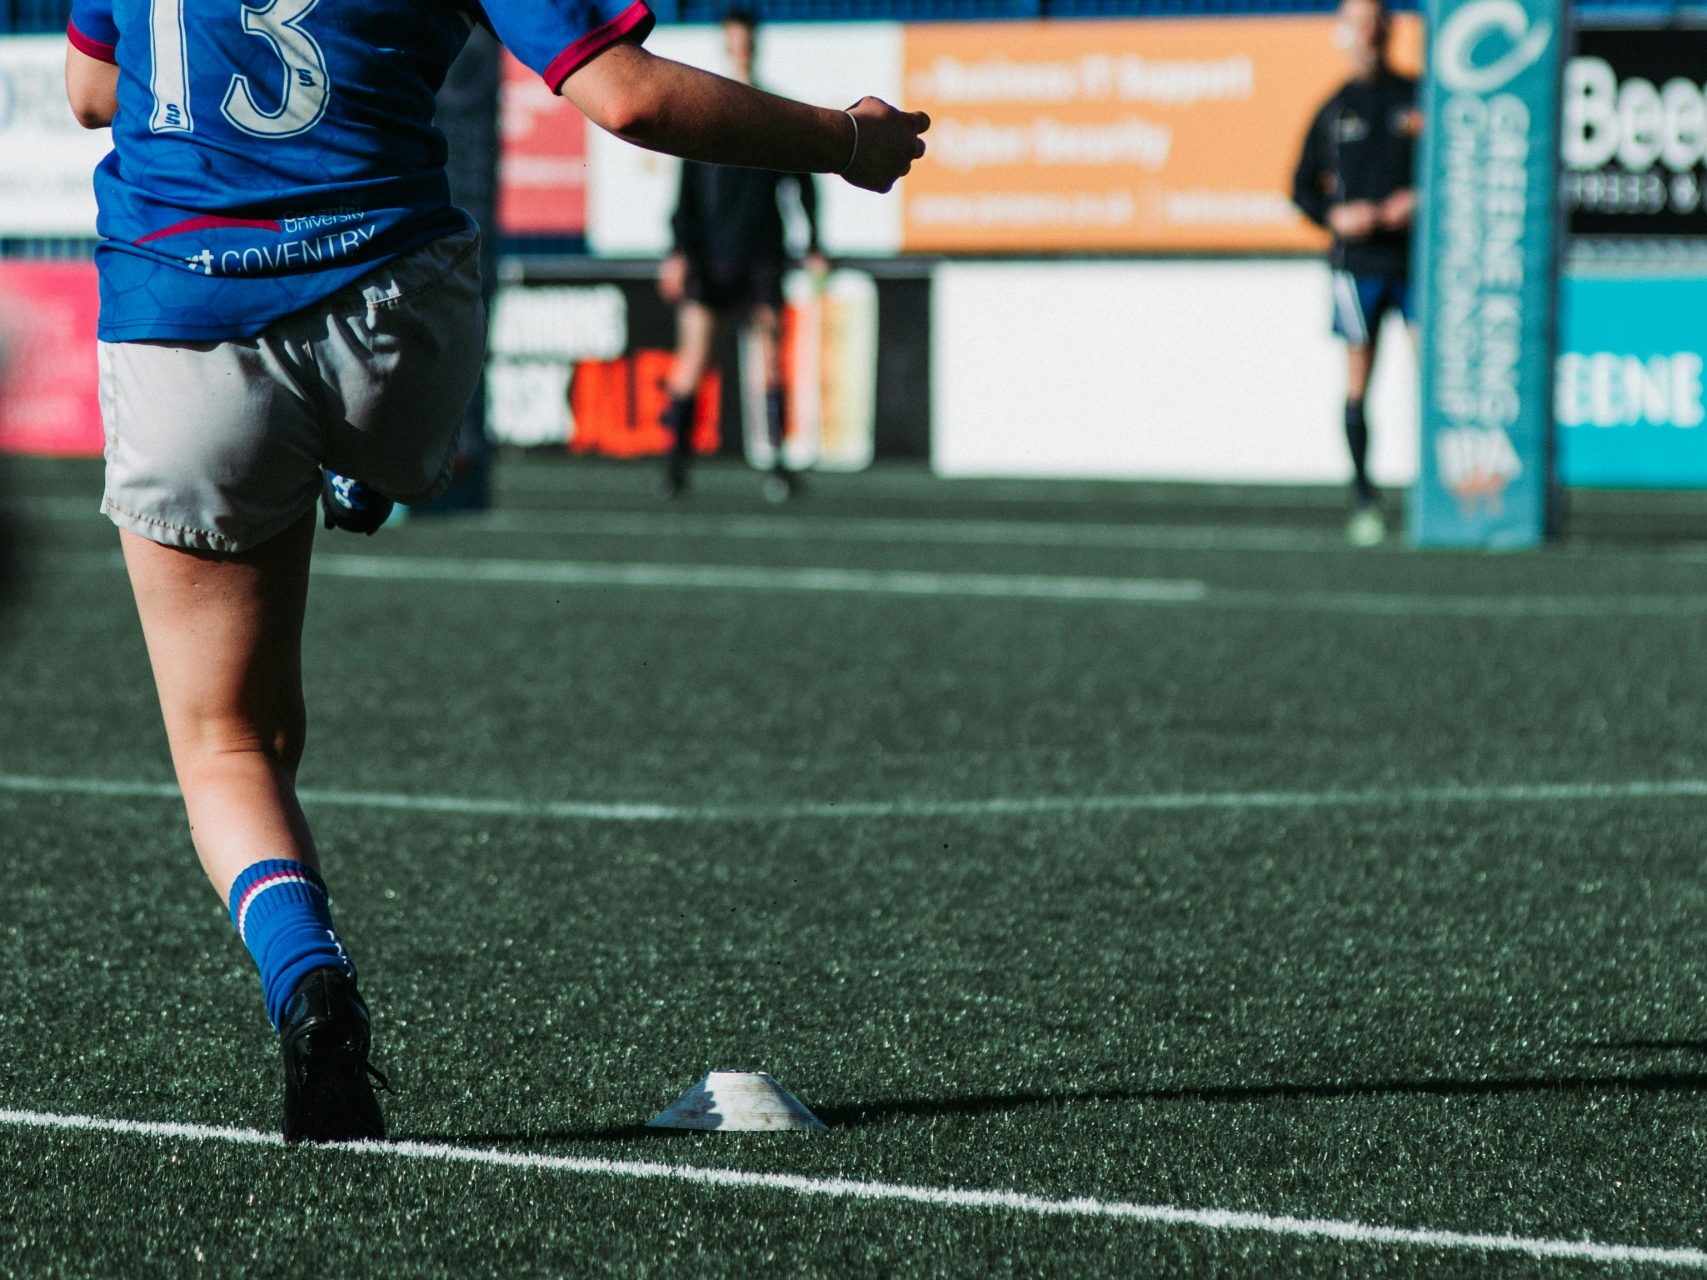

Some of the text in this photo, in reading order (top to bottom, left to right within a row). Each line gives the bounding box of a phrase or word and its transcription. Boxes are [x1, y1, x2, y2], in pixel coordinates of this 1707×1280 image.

[1562, 55, 1707, 170] Bee
[284, 211, 364, 233] University
[221, 224, 375, 274] COVENTRY
